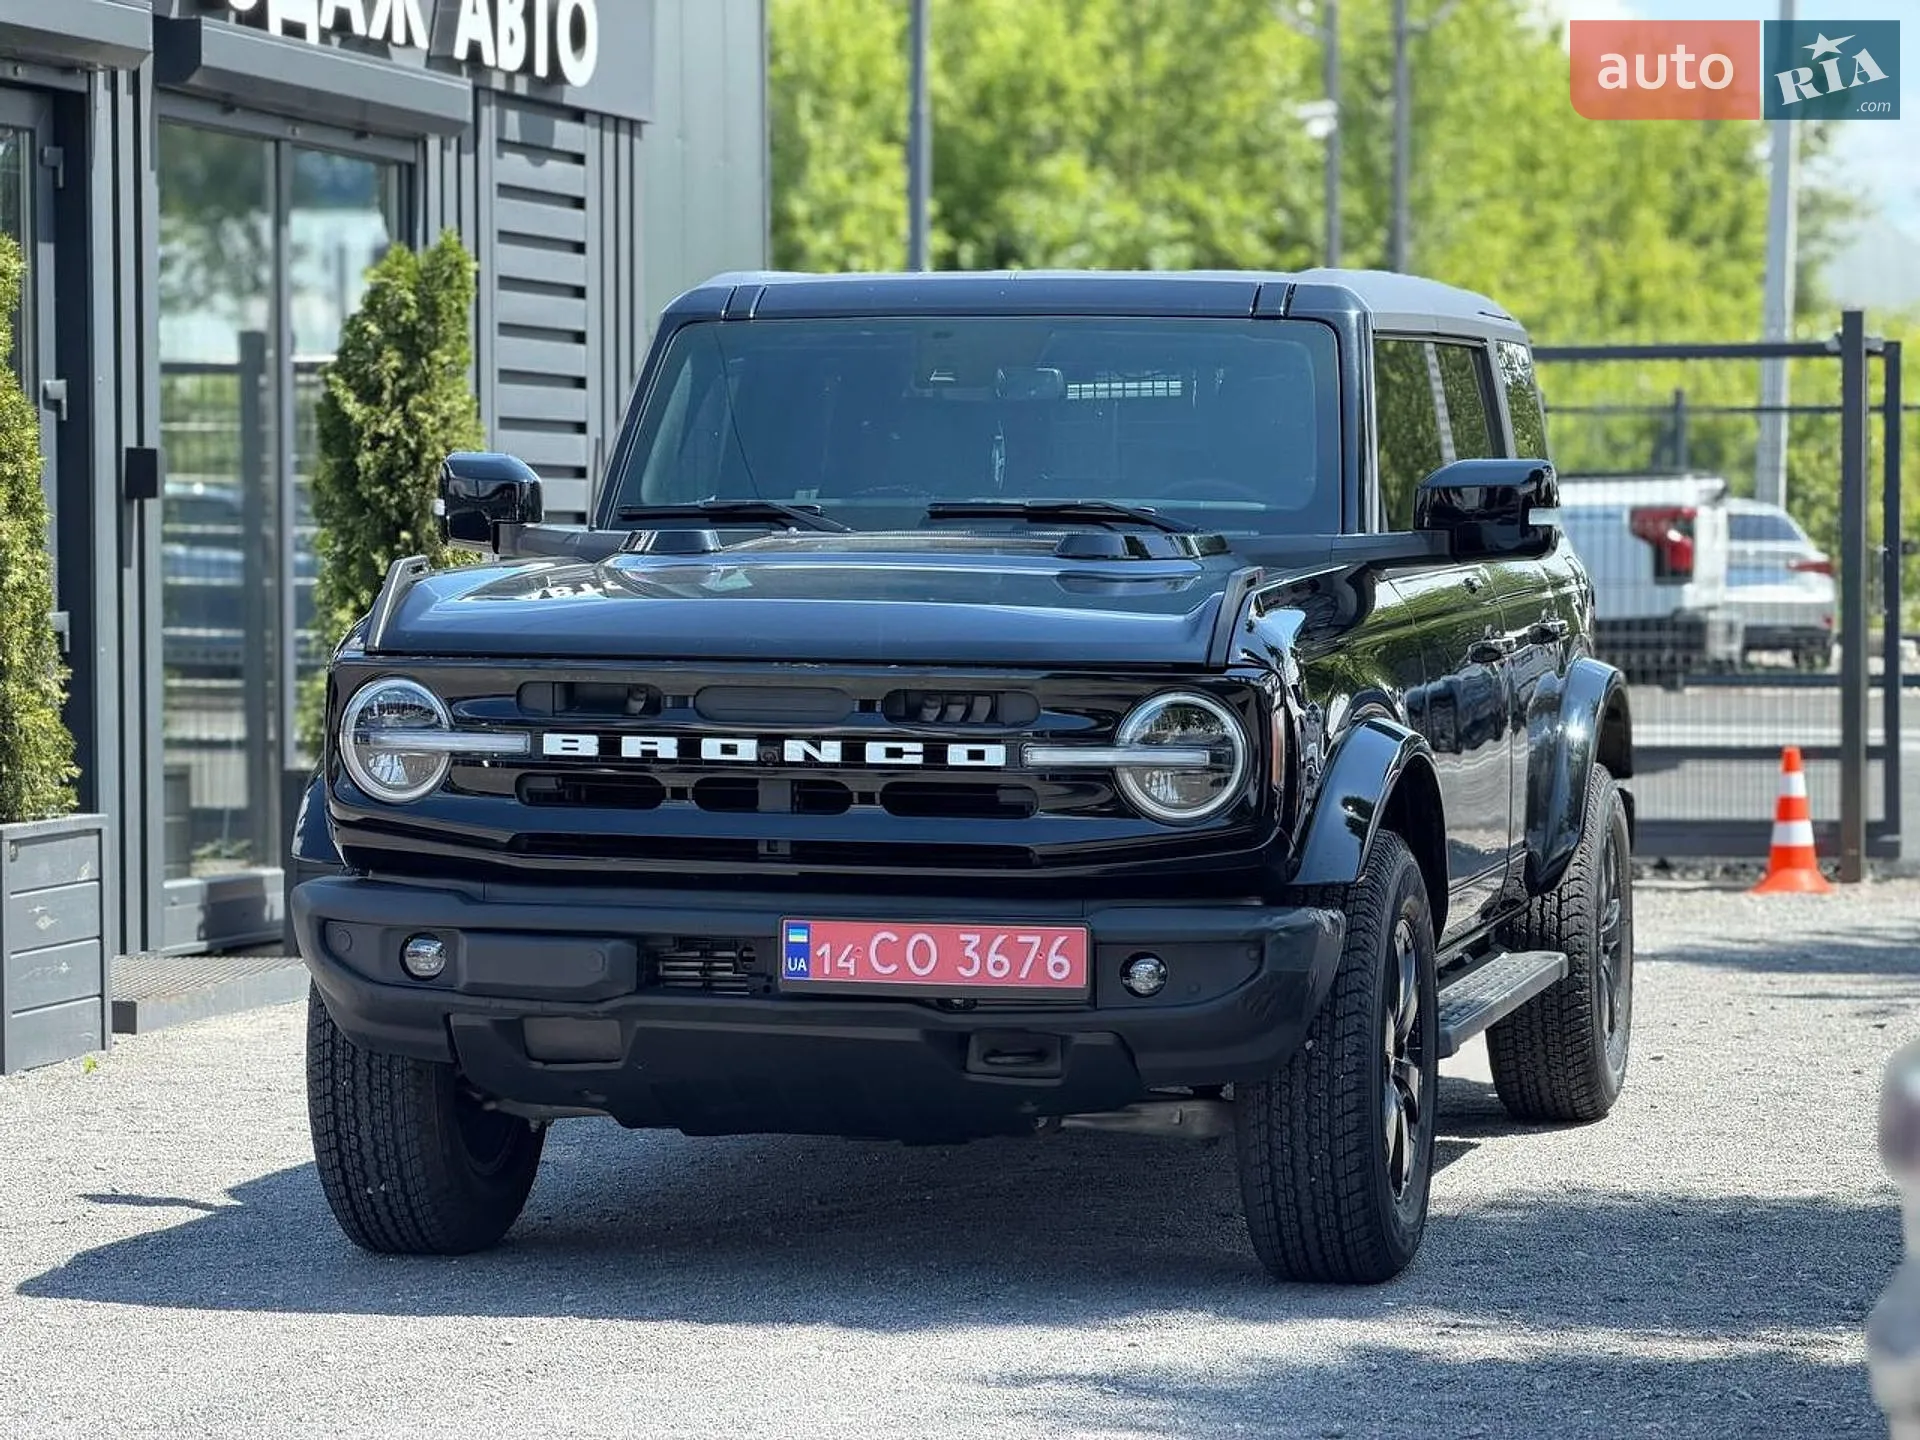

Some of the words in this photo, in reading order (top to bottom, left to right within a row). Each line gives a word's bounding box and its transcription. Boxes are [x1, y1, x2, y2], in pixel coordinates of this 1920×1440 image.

[542, 732, 1006, 767] BRONCO
[788, 958, 807, 972] UA
[957, 933, 1071, 981] 3676
